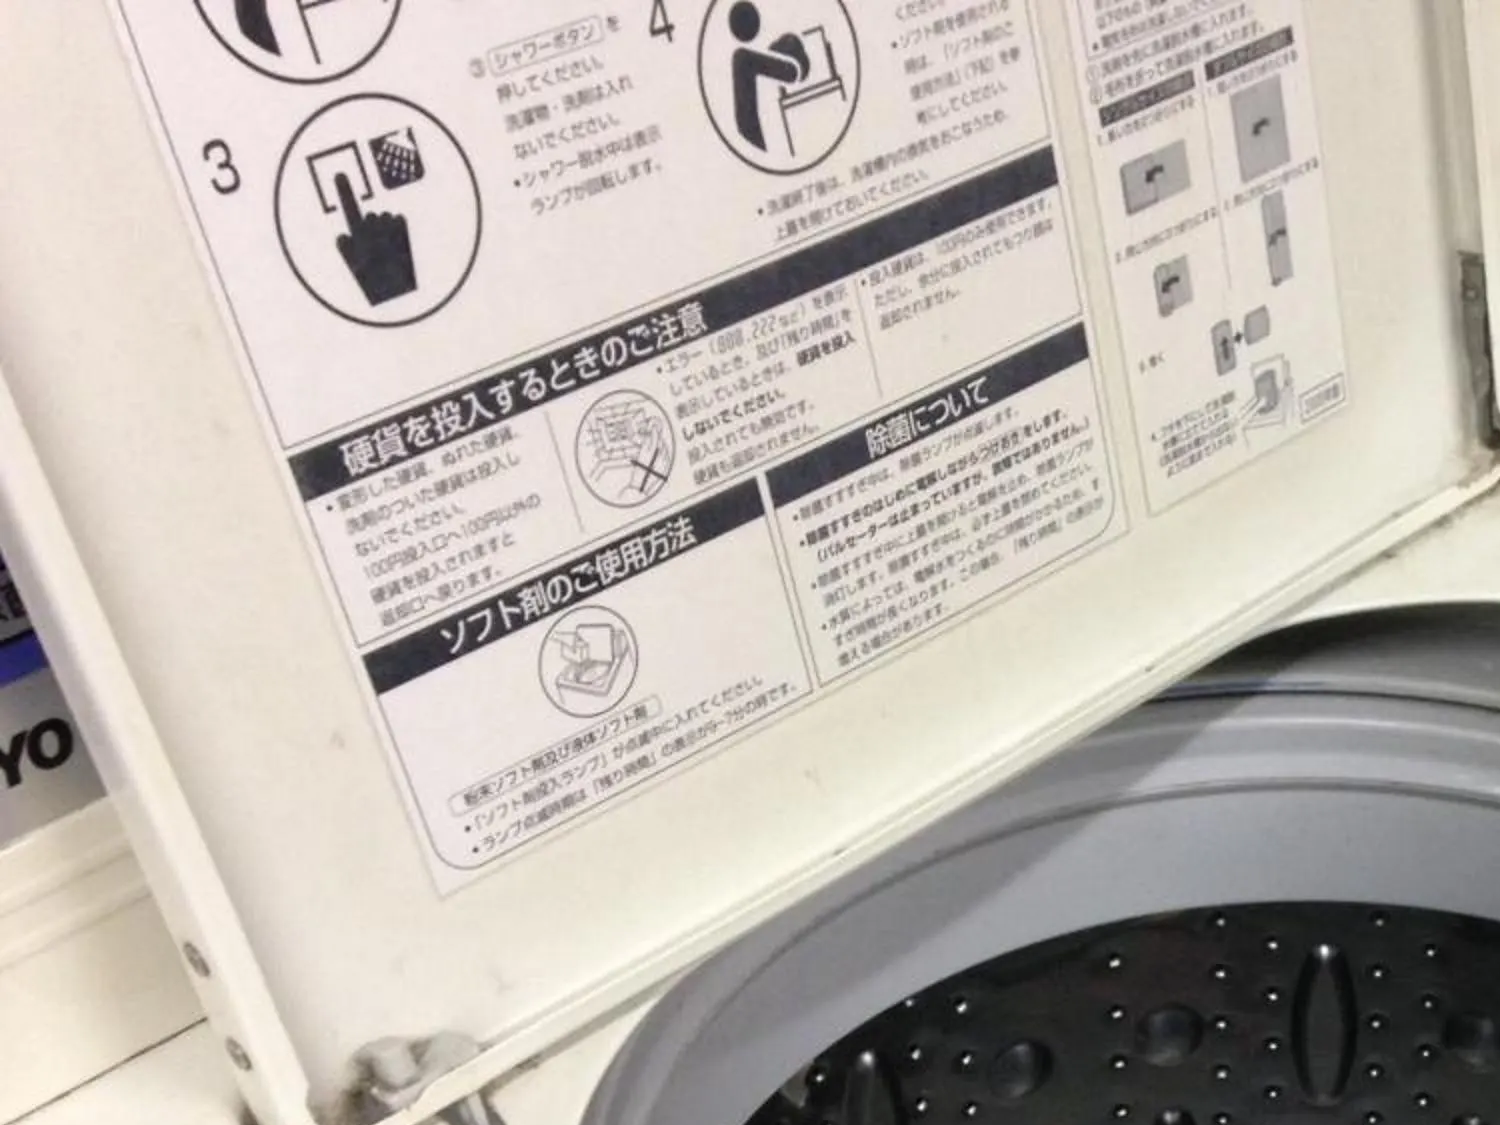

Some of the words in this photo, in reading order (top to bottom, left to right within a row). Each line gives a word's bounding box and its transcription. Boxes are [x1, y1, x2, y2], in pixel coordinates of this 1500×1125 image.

[494, 24, 594, 69] シャワーボタン
[649, 0, 675, 42] 4
[204, 139, 241, 195] 3
[339, 302, 708, 476] 硬貨を投入するときのご注意
[866, 376, 990, 459] 除菌について
[441, 515, 698, 654] ソフト剤のご使用方法
